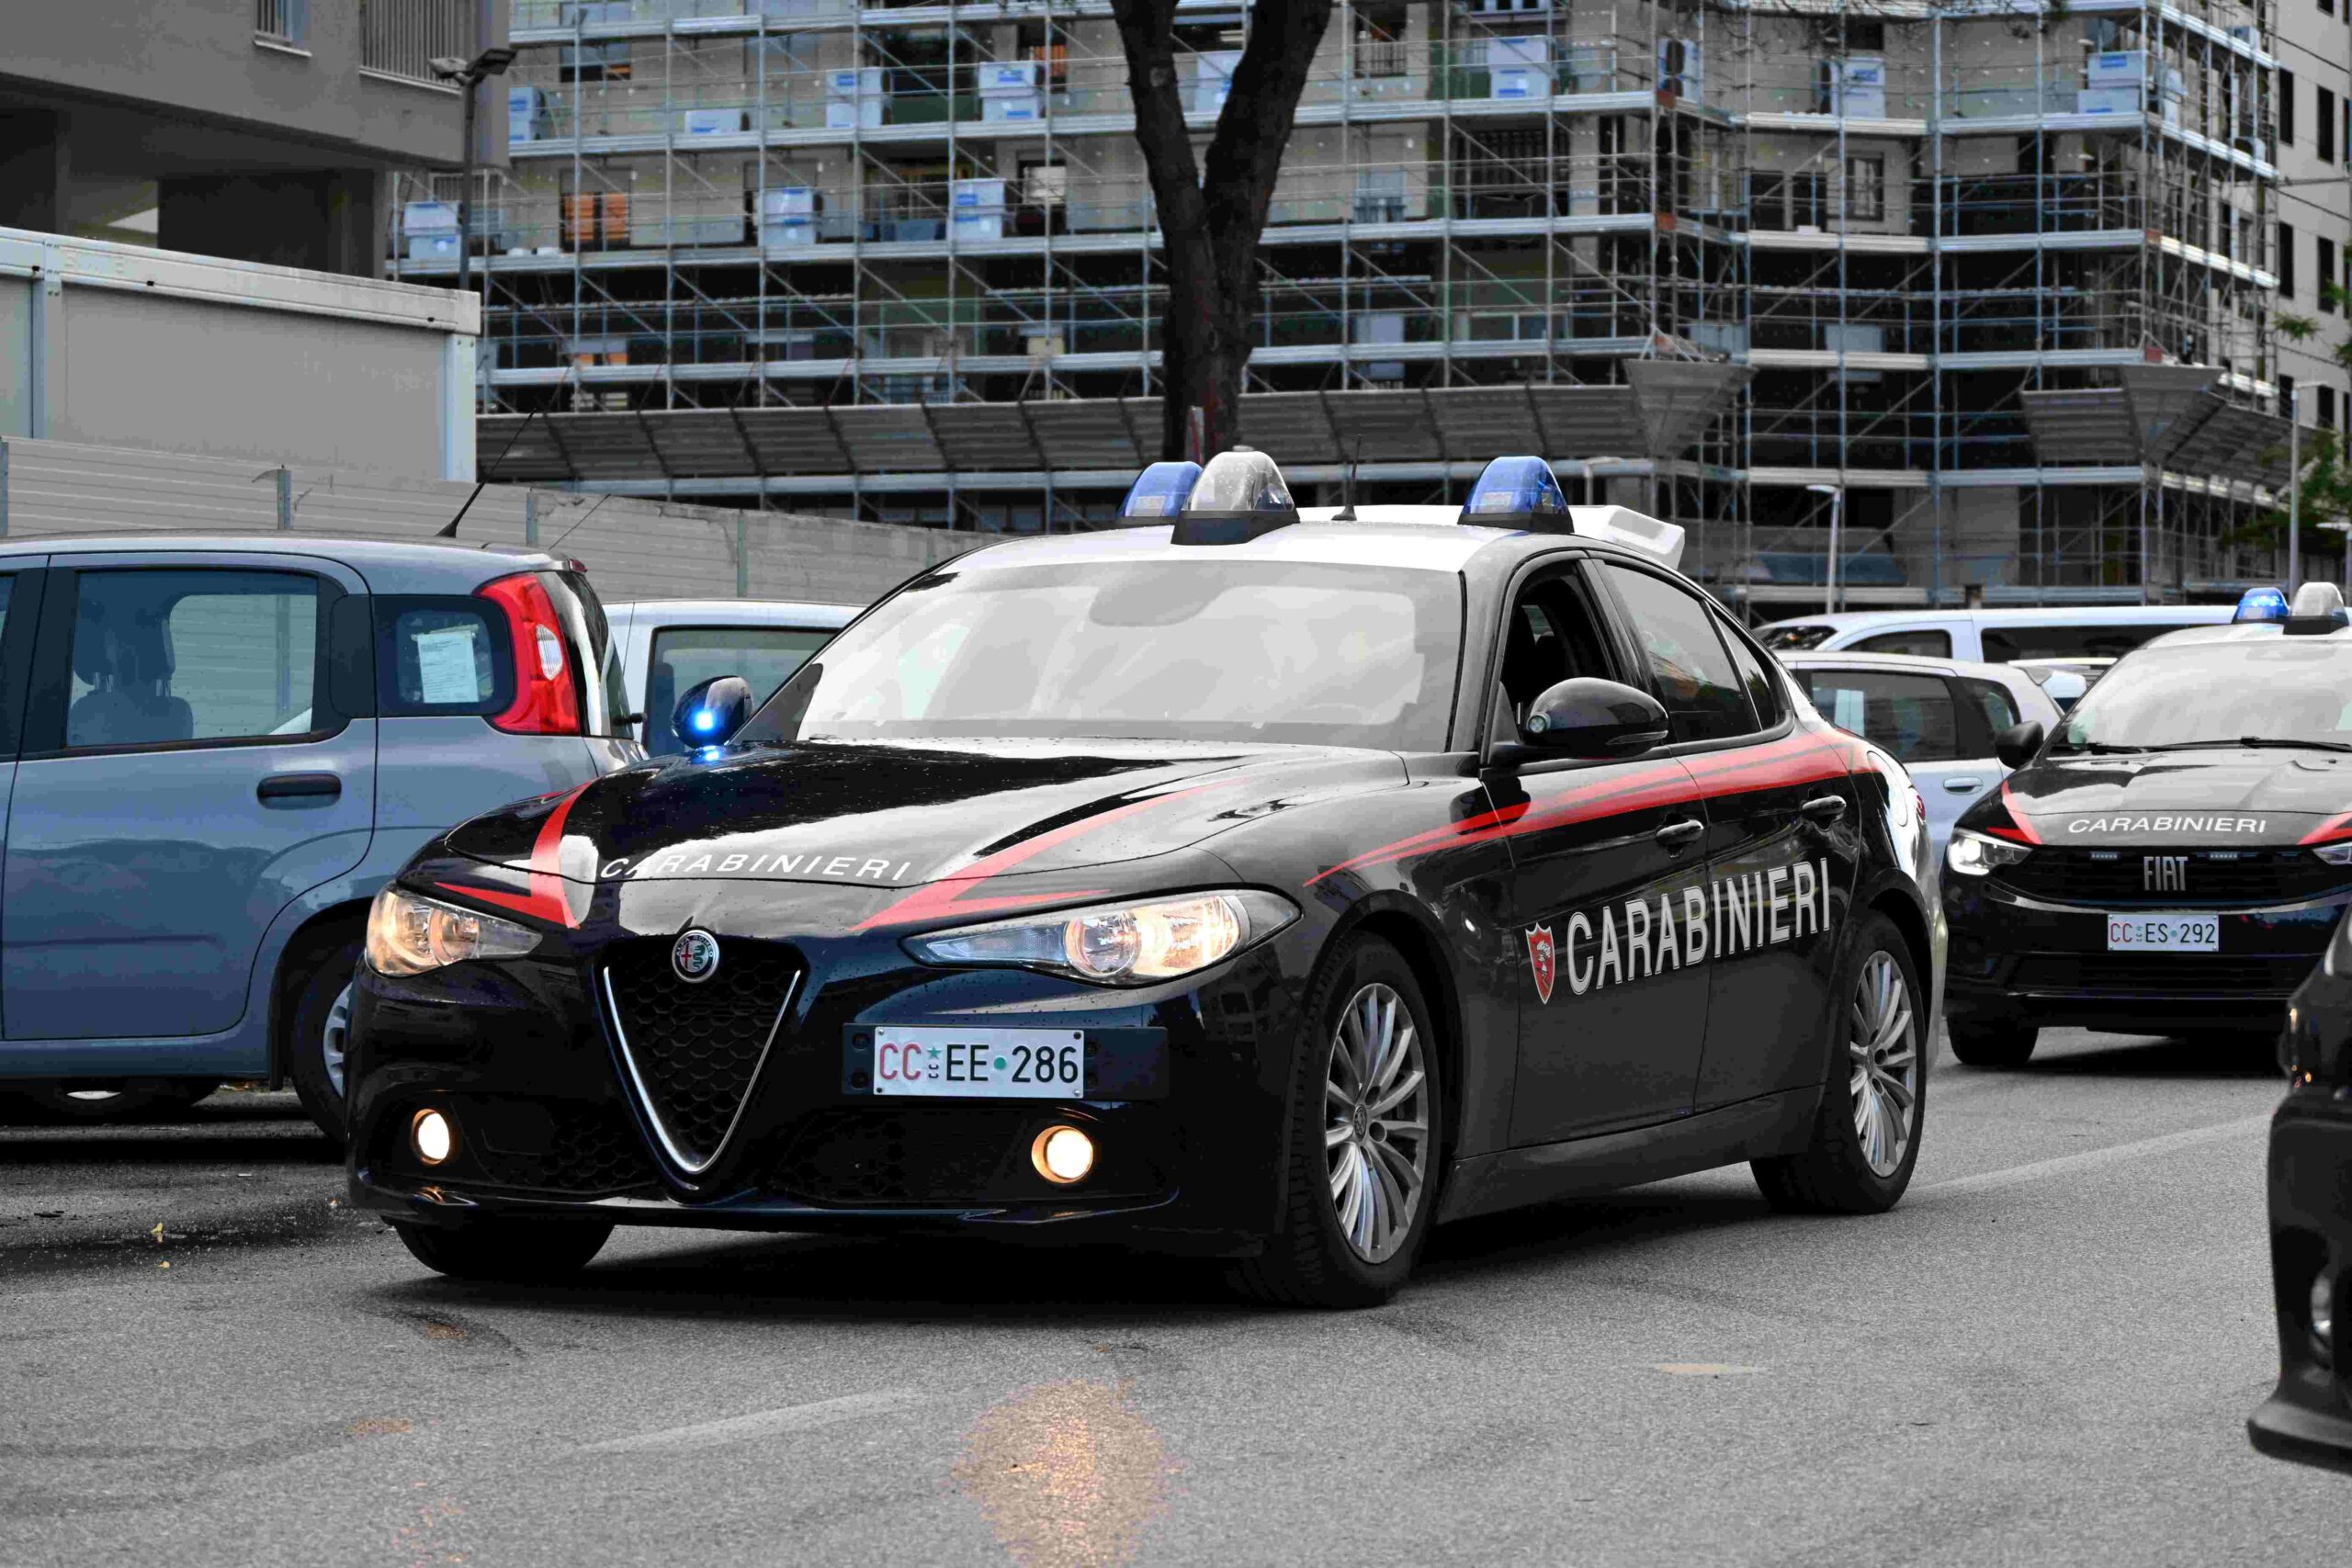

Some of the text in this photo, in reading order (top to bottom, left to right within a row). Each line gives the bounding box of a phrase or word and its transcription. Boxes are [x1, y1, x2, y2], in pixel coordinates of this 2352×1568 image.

[2068, 817, 2267, 834] CARABINIERI
[601, 853, 911, 880] CARABINIERI
[2143, 856, 2188, 891] FIAT
[1567, 857, 1830, 996] CARABINIERI
[2110, 922, 2132, 943] CC
[2145, 922, 2168, 943] ES
[2179, 922, 2216, 943] 292
[879, 1043, 1079, 1083] CC EE 286
